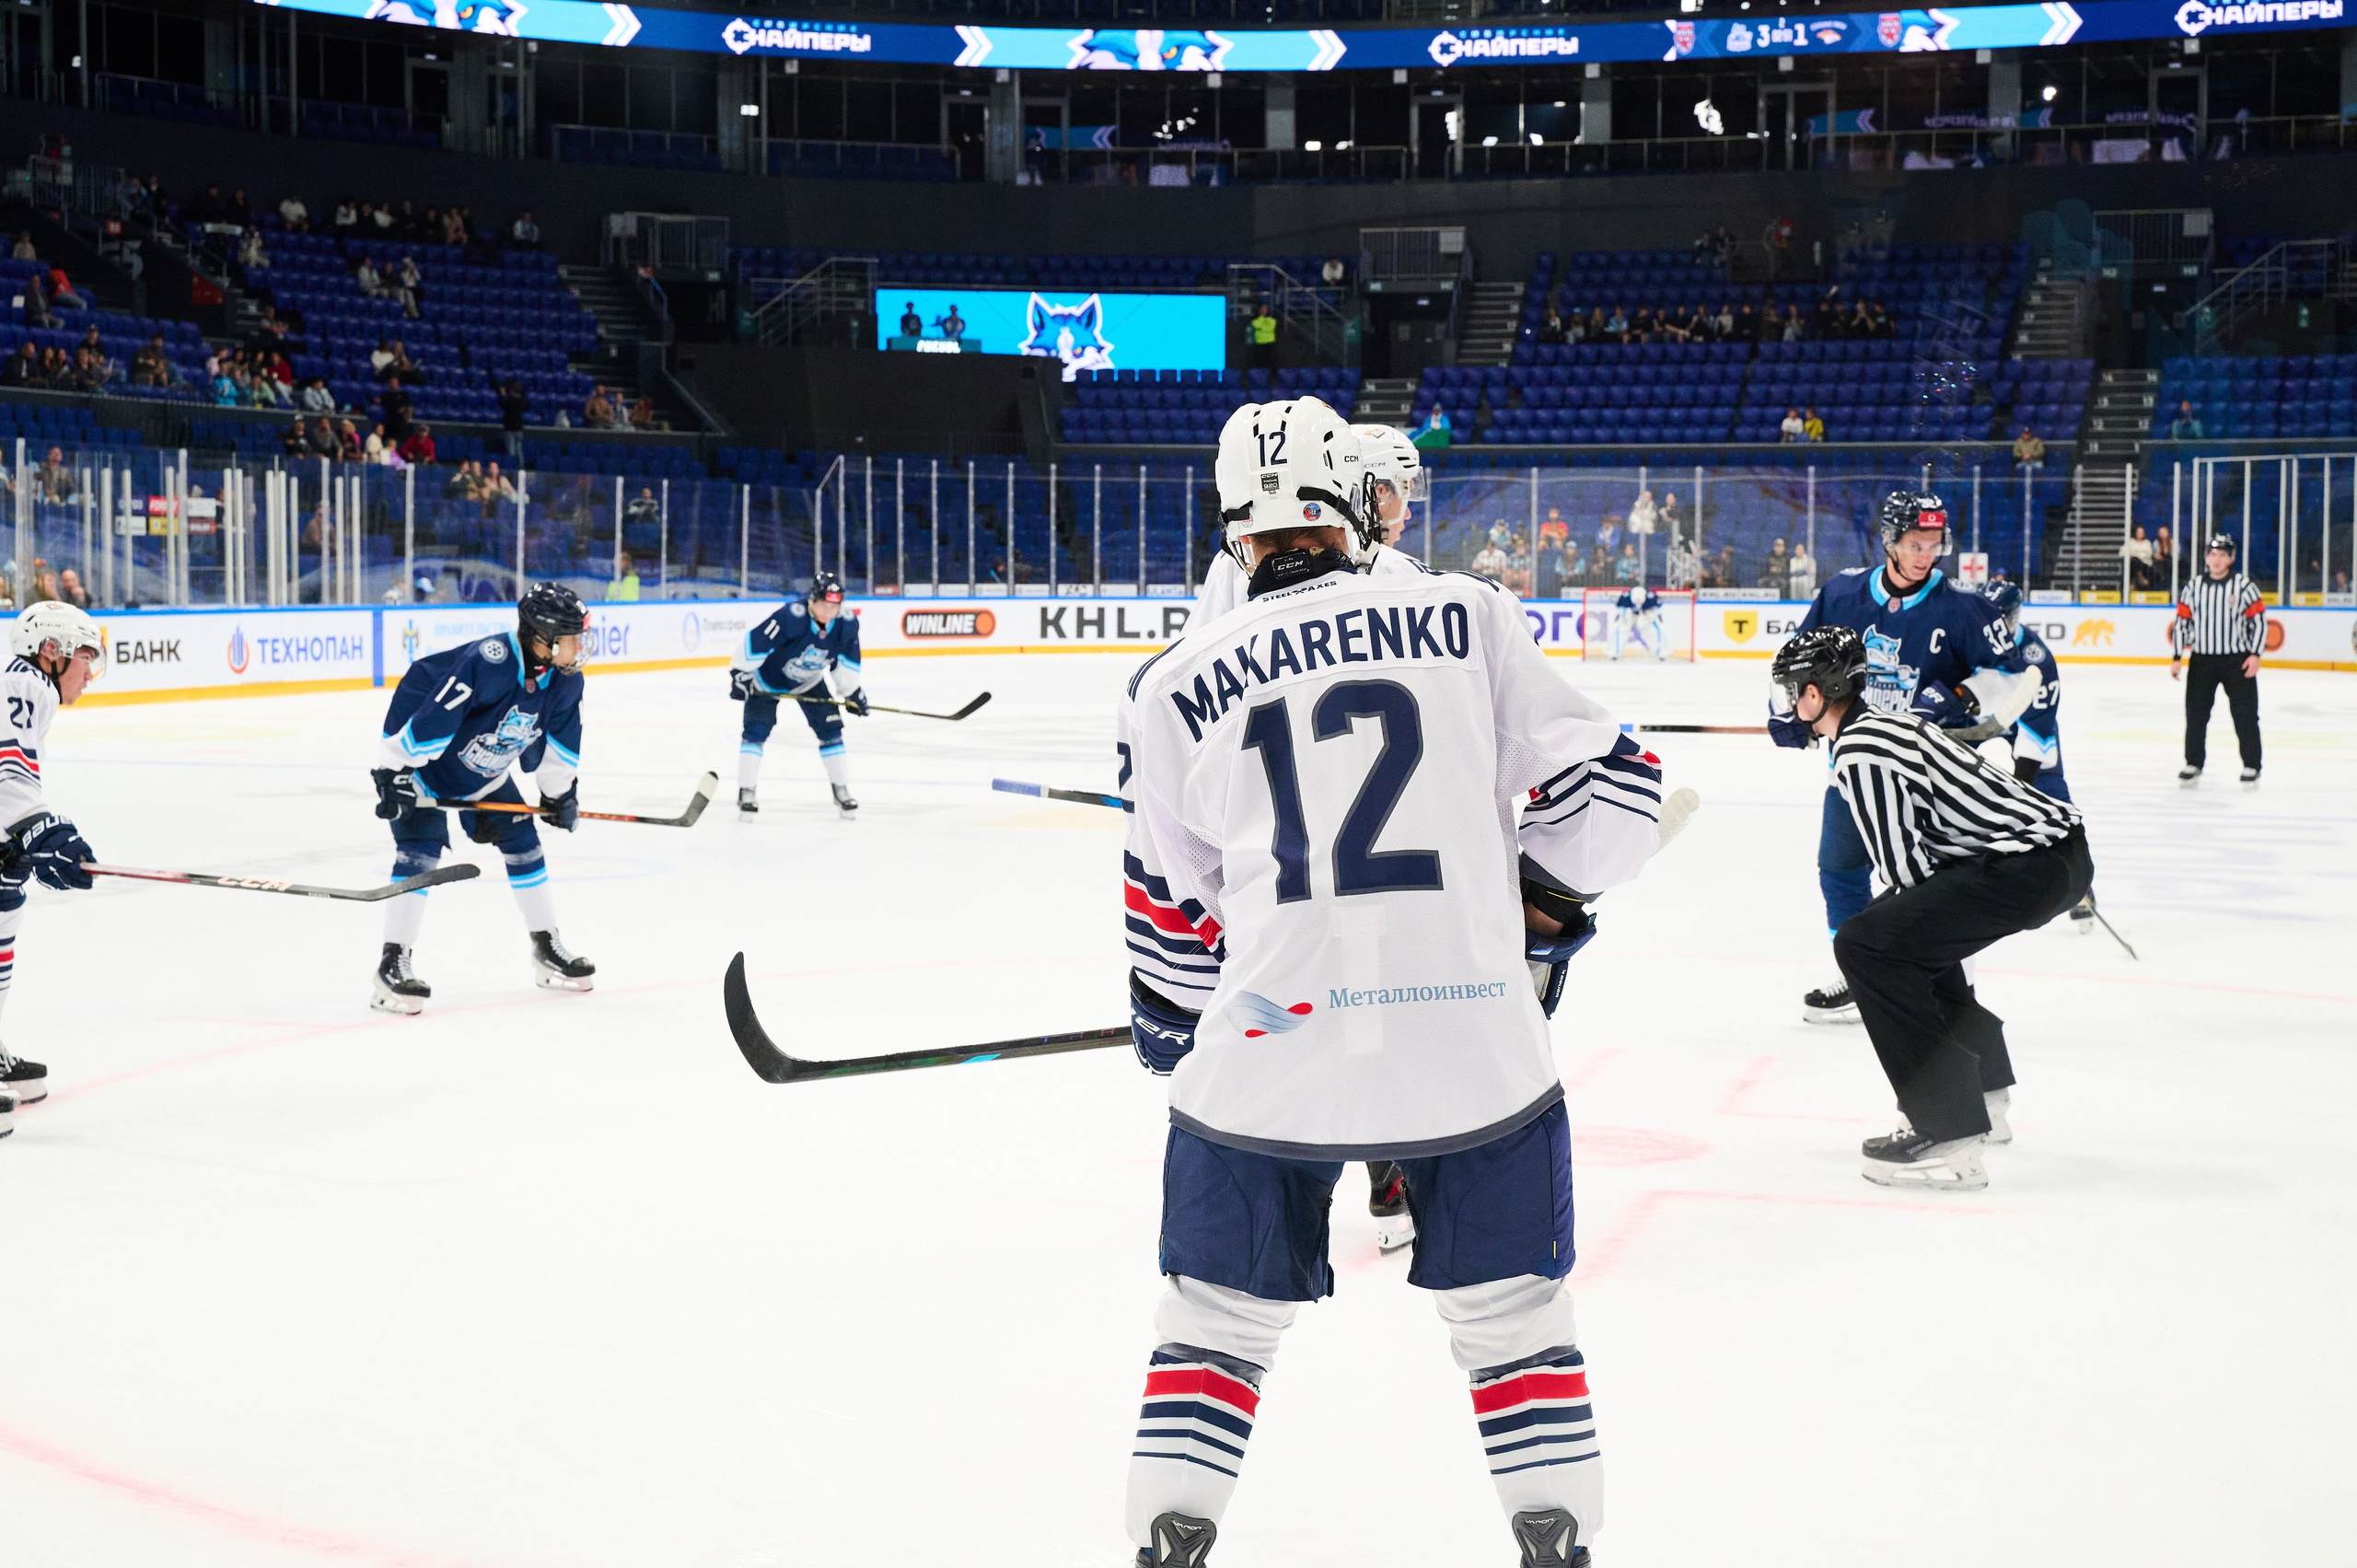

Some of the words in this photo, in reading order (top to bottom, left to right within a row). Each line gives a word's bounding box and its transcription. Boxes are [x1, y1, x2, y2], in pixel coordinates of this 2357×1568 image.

[1258, 431, 1288, 467] 12
[1344, 455, 1359, 463] CCM
[1277, 560, 1304, 571] CCM
[1262, 591, 1293, 603] STEEL
[1307, 580, 1337, 592] AXES
[906, 614, 976, 634] WINLINE
[1039, 606, 1190, 639] KHL.R
[1983, 618, 2013, 656] 32
[116, 640, 181, 664] БАНК
[258, 635, 364, 664] ТЕХНОПАН
[1170, 602, 1469, 743] MAKARENKO
[435, 676, 472, 711] 17
[1241, 679, 1444, 905] 12
[1329, 981, 1506, 1009] Металлоинвест
